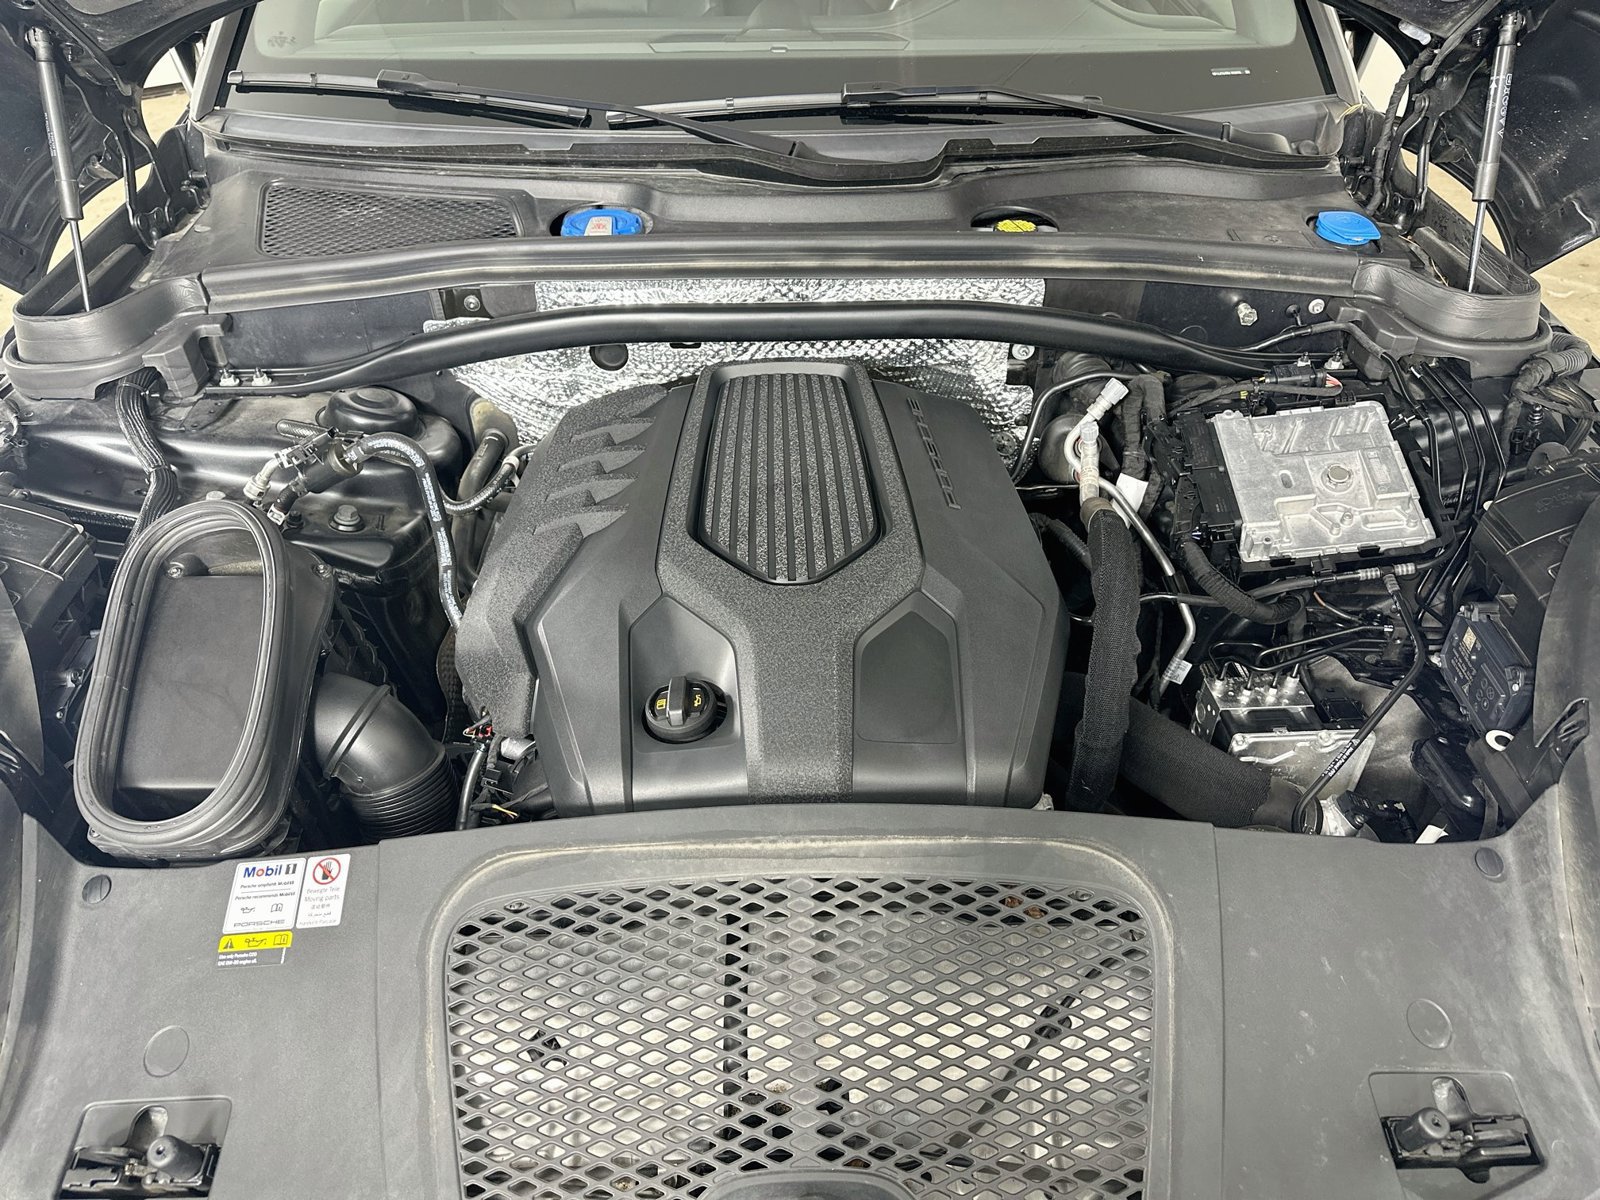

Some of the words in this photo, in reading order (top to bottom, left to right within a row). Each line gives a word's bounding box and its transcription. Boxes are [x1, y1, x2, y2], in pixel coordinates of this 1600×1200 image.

[906, 397, 961, 509] PORSCHE
[243, 865, 282, 878] Mobil
[285, 863, 297, 875] 1
[233, 919, 286, 927] PORSCHE
